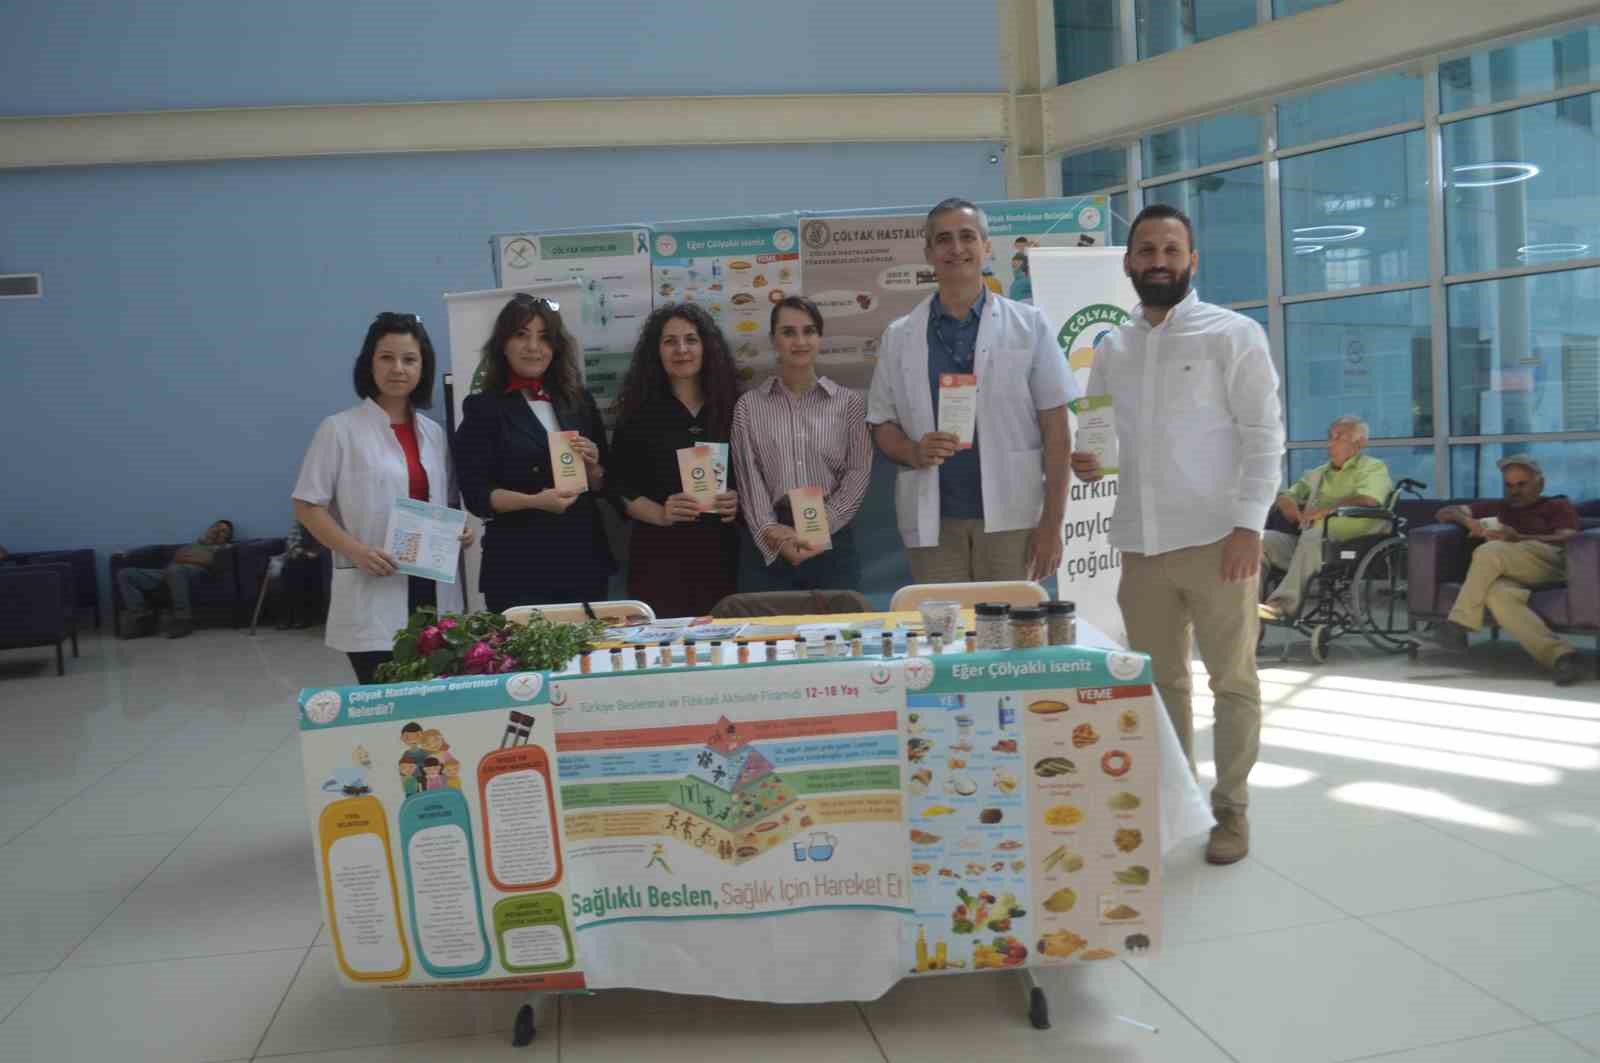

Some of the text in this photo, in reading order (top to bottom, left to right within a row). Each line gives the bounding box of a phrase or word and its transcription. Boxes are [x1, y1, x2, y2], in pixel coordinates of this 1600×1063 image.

[1071, 479, 1119, 501] arkın
[1064, 511, 1112, 545] payla
[1067, 547, 1121, 583] çoğalı
[951, 663, 986, 680] Eğer
[988, 660, 1047, 678] Çölyaklı
[1078, 687, 1113, 700] YEME
[571, 884, 641, 917] Sağlıklı
[647, 883, 719, 909] Beslen,
[813, 872, 883, 897] Hareket
